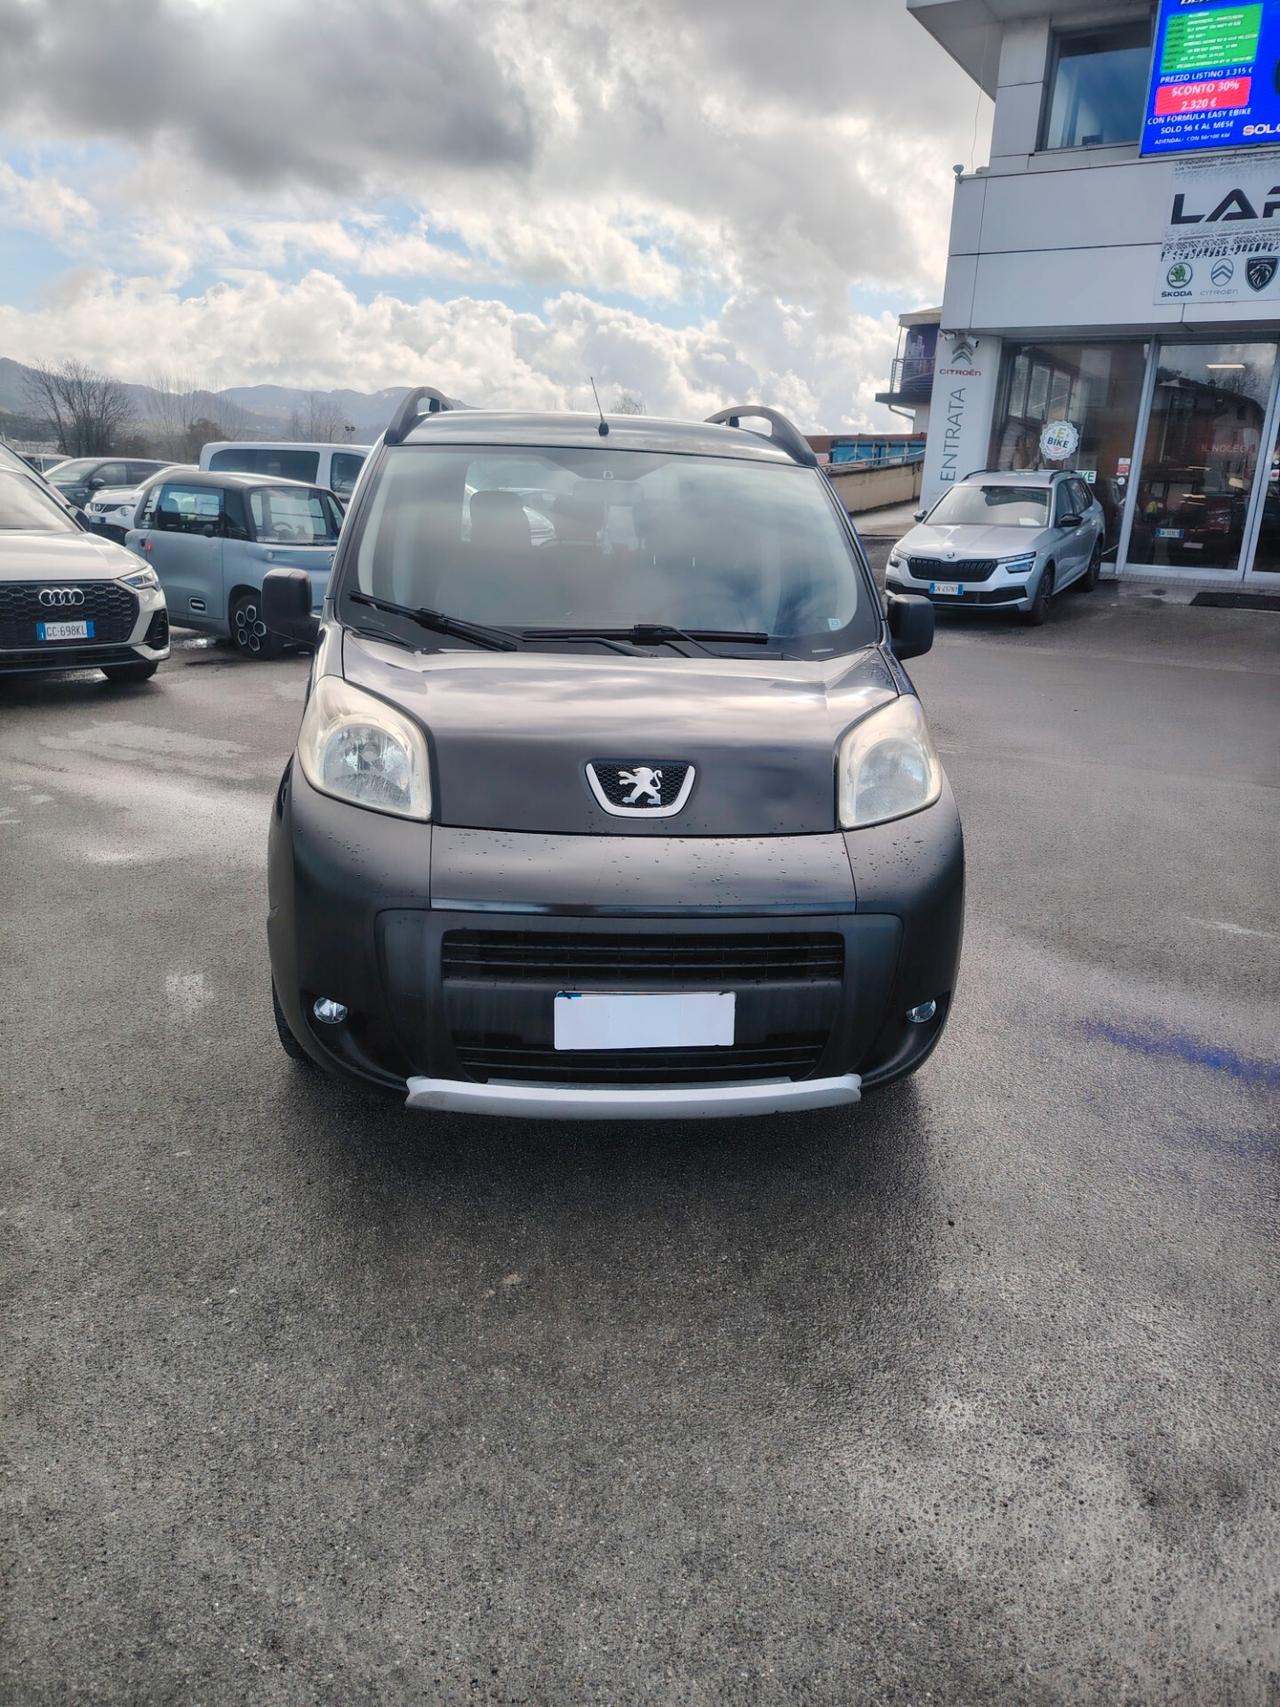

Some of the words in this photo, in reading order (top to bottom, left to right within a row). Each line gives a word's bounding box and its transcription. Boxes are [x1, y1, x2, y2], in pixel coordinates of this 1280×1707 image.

[1160, 73, 1190, 83] PREZZO
[1191, 71, 1224, 80] LISTINO
[1171, 83, 1215, 97] SCONTO
[1217, 80, 1240, 91] 30%
[1180, 99, 1208, 111] 2.320
[1209, 97, 1217, 107] €
[1147, 116, 1164, 125] CON
[1166, 112, 1206, 123] FORMULA
[1207, 110, 1227, 119] EASY
[1228, 107, 1252, 117] EBIKE
[1160, 125, 1182, 134] SOLO
[1183, 124, 1193, 132] 56
[1194, 123, 1200, 131] €
[1213, 120, 1234, 129] MESE
[940, 387, 967, 482] ENTRATA
[1047, 436, 1070, 449] BIKE
